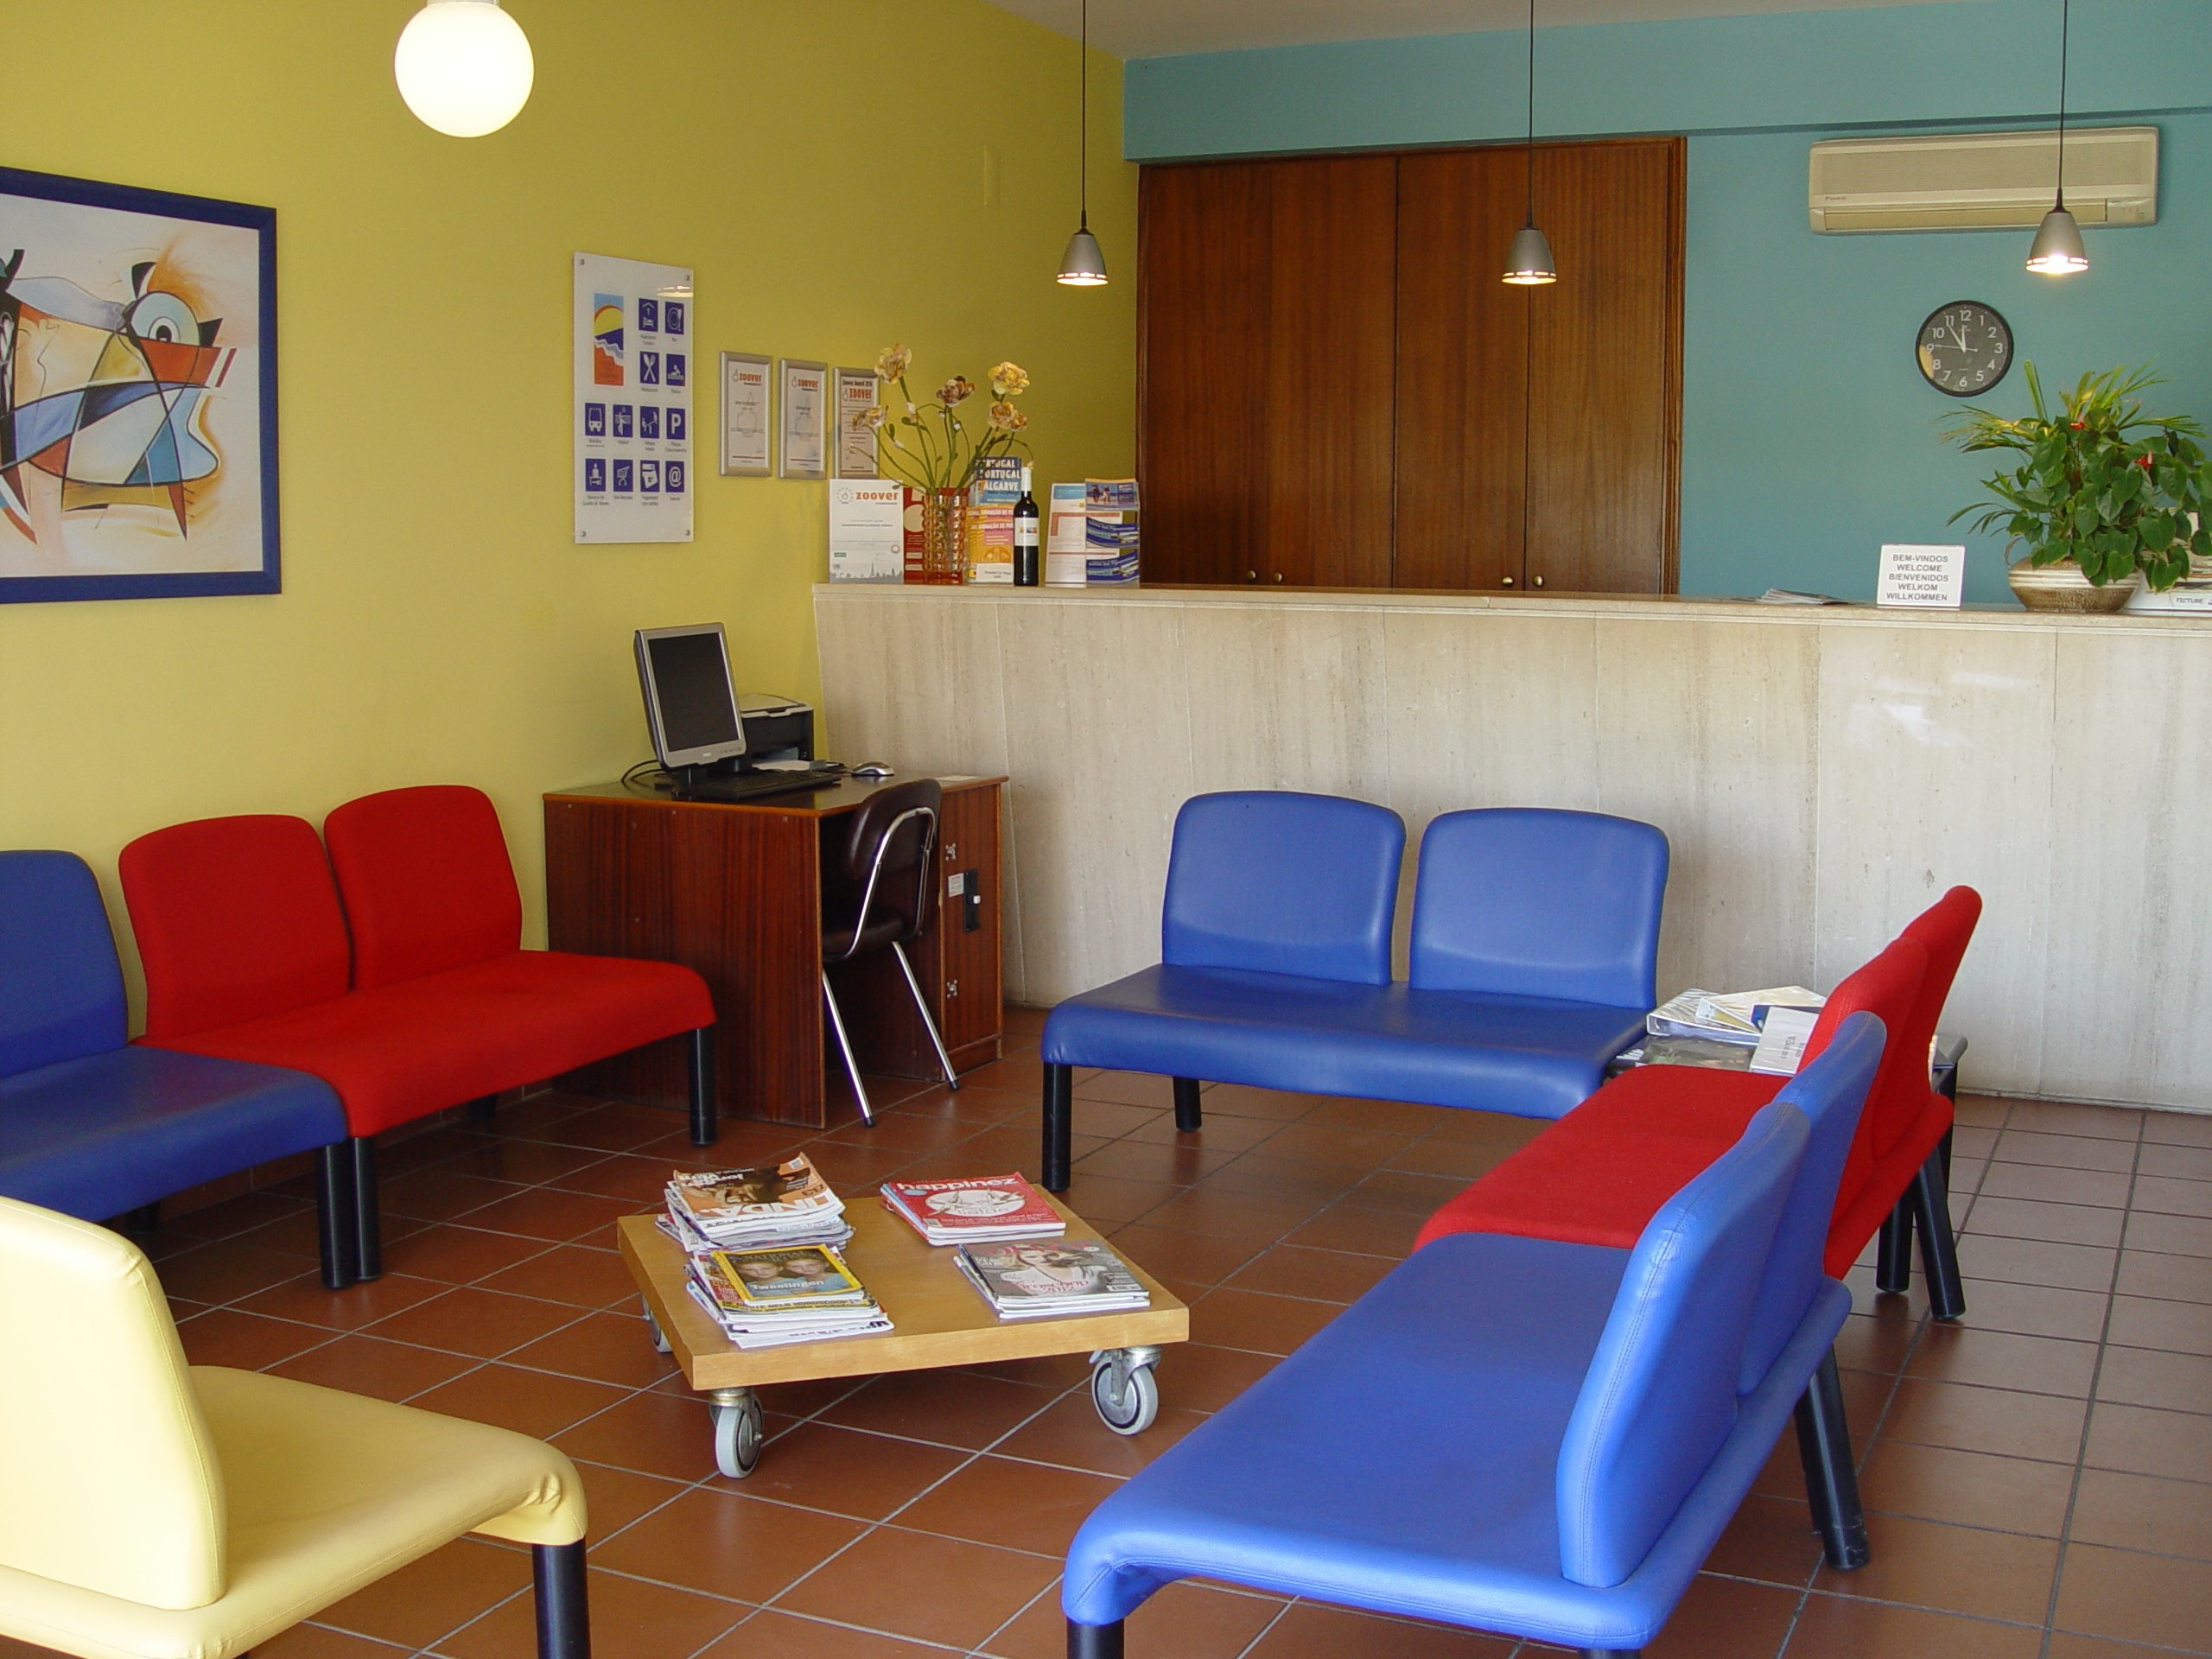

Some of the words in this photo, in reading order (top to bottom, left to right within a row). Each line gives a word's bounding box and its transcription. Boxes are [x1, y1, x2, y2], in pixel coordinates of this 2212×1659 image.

[1959, 309, 1972, 321] 12
[1944, 315, 1955, 327] 11
[1979, 315, 1985, 327] 1
[1932, 327, 1945, 339] 10
[1987, 327, 1997, 338] 2
[1926, 343, 1935, 354] 9
[1994, 342, 2003, 353] 3
[1933, 359, 1942, 370] 8
[1987, 359, 1996, 370] 4
[1943, 370, 1952, 381] 7
[1975, 370, 1985, 381] 5
[1959, 376, 1968, 387] 6
[983, 480, 1019, 491] ALGARVE
[855, 492, 899, 500] zoover
[1892, 554, 1948, 563] BEM-VINDOS
[1897, 563, 1942, 572] WELCOME
[1889, 573, 1948, 582] BIENVENIDOS
[1886, 592, 1948, 601] WILLKOMMEN
[897, 1178, 1020, 1191] happinez
[749, 1281, 824, 1290] Tweelingen
